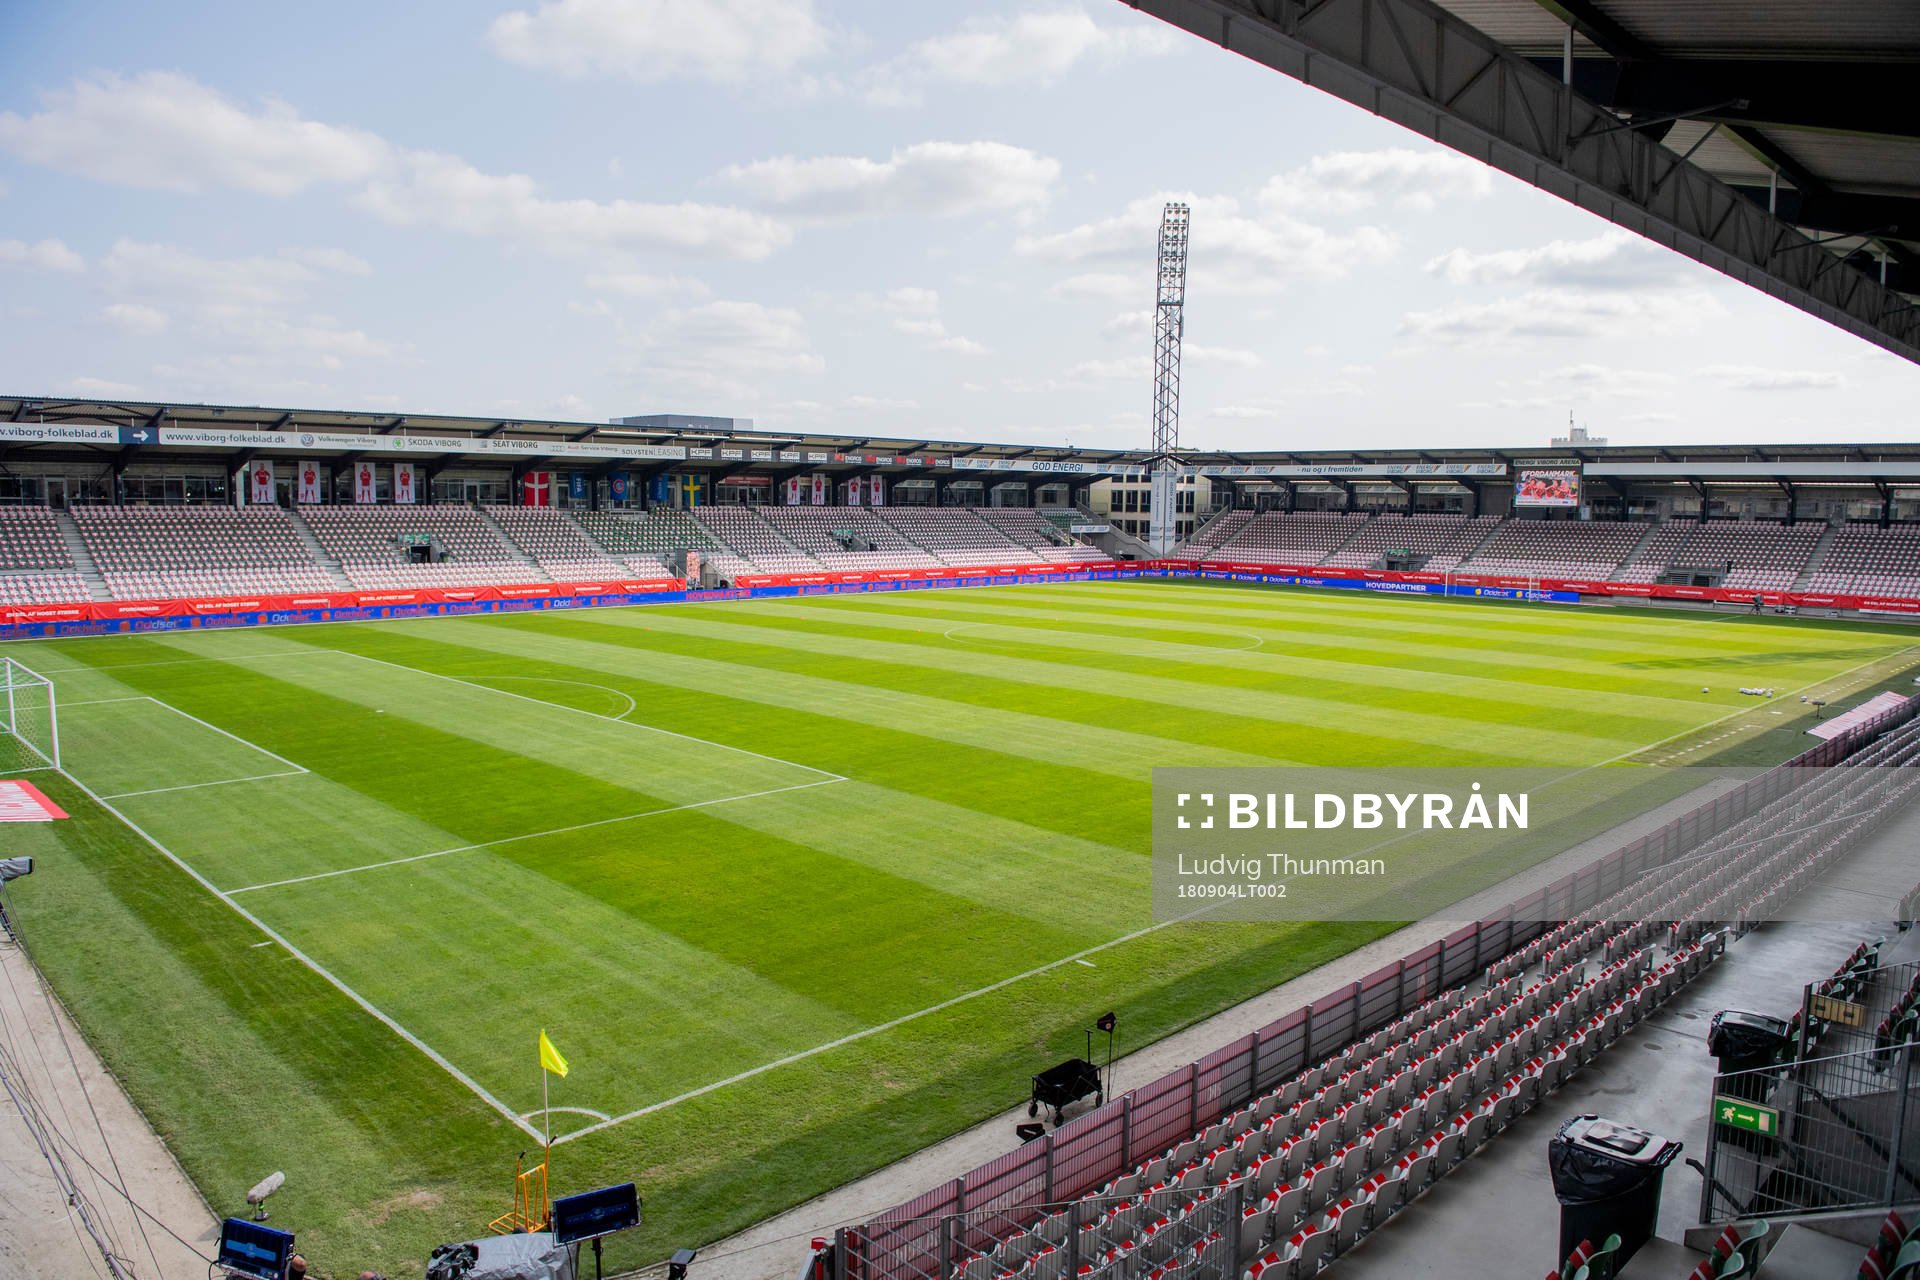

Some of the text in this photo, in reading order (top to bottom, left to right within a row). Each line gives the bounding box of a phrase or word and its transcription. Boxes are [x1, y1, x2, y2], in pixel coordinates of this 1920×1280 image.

[166, 432, 286, 444] www.viborg-folkeblad.dk
[492, 440, 538, 449] SEAT VIBORG
[1032, 462, 1083, 472] GOD ENERGI
[1328, 465, 1363, 473] fremtiden
[1365, 581, 1427, 592] HOVEDPARTNER
